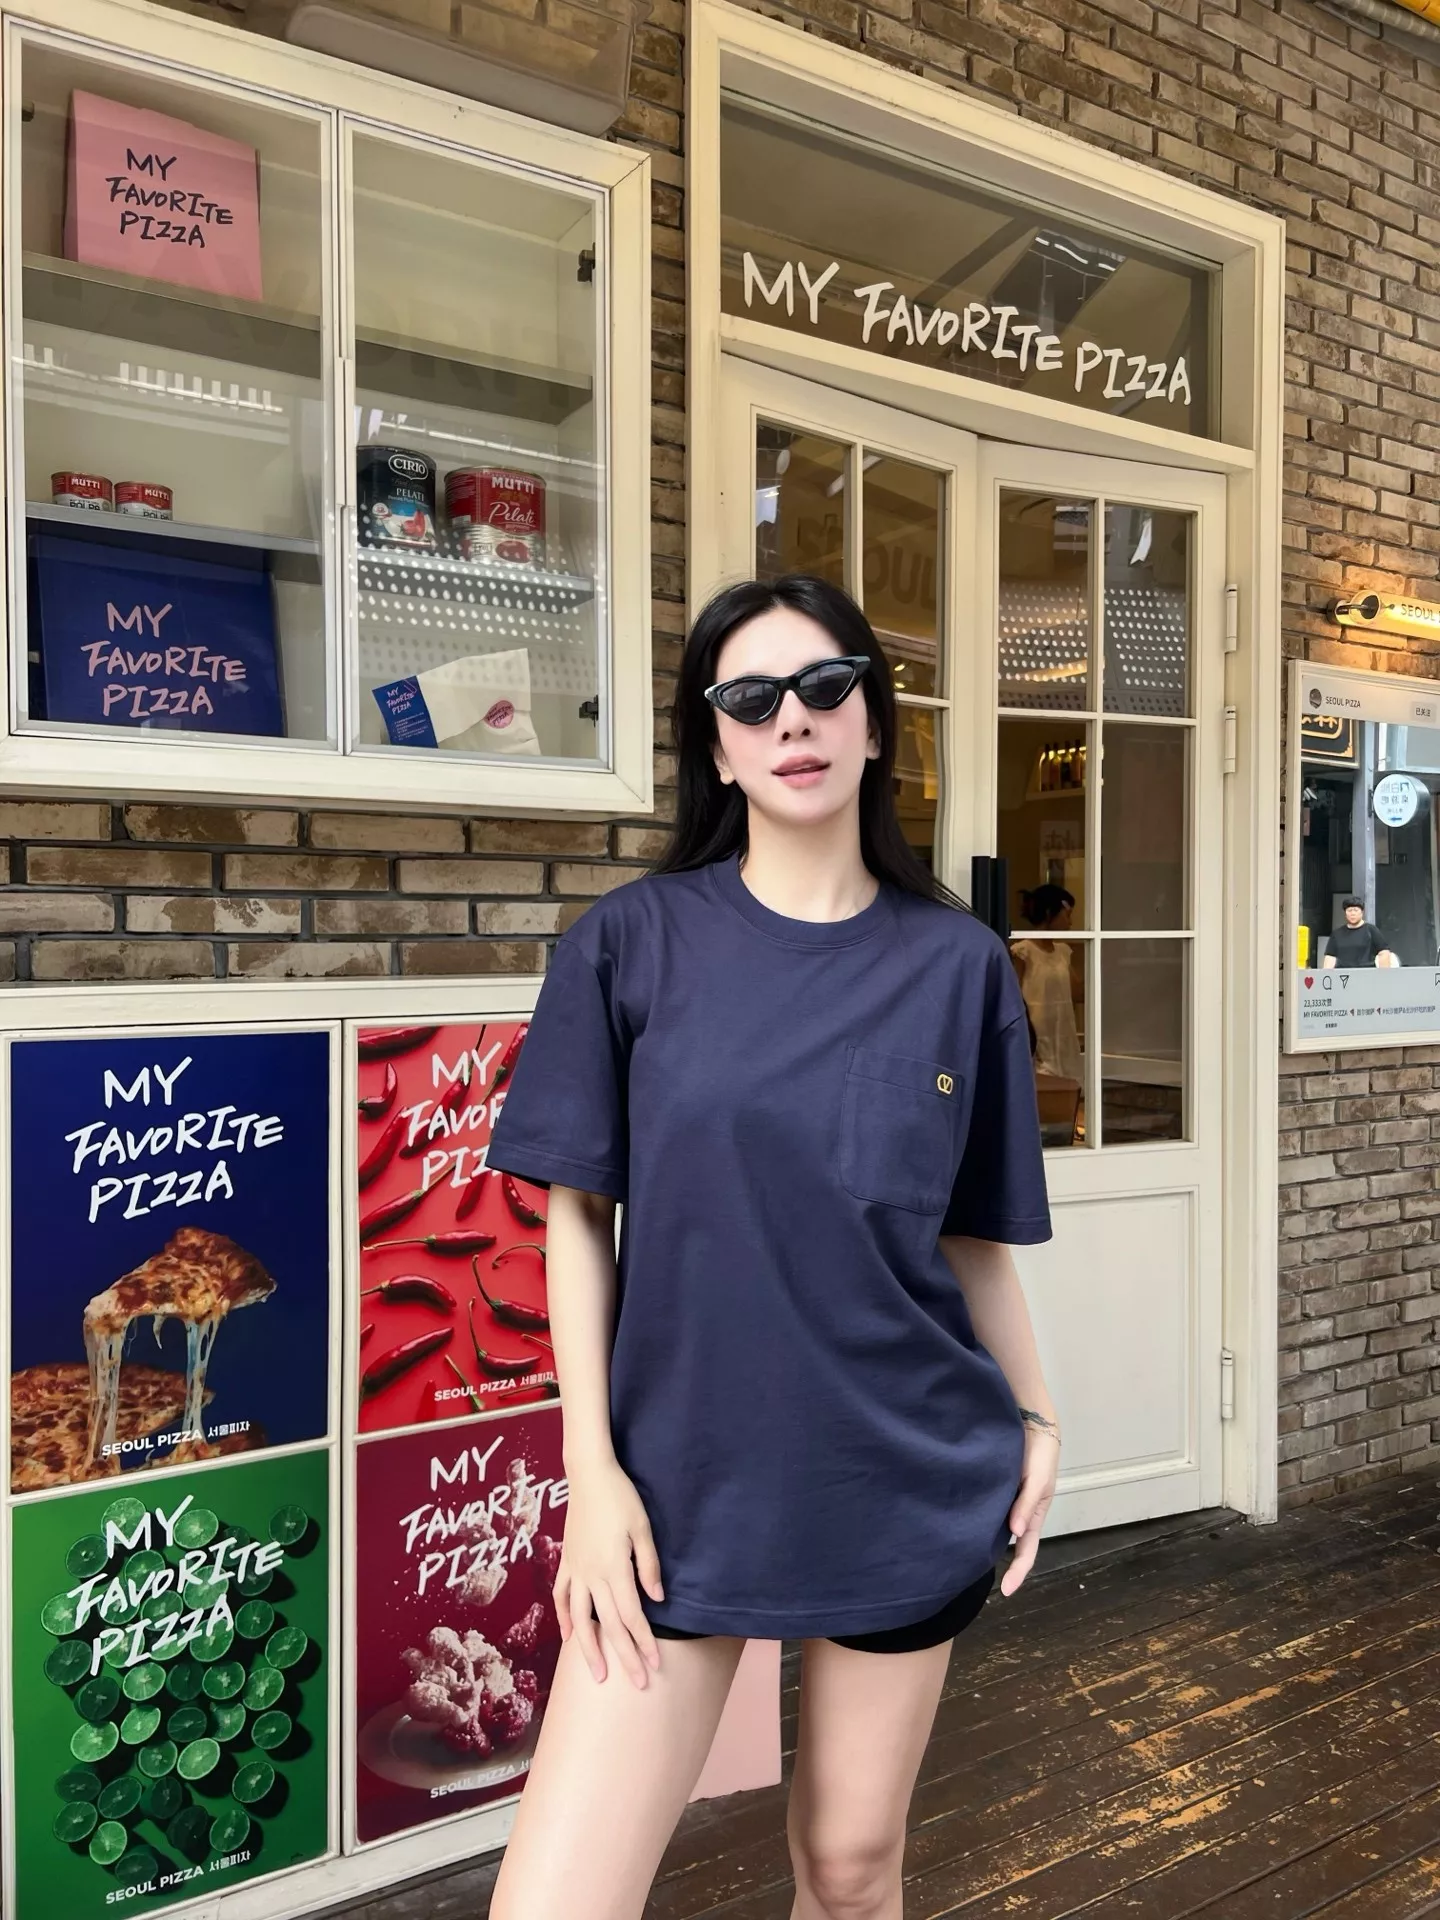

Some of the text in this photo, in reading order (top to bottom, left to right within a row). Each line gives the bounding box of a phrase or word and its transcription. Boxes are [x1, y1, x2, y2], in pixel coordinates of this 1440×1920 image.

[127, 148, 177, 181] MY
[105, 177, 233, 224] FAVORITE
[120, 211, 205, 248] PIZZA
[743, 252, 1191, 405] MY FAVORITE PIZZA
[71, 478, 100, 489] MUTTI
[393, 458, 426, 474] CIRIO
[144, 487, 170, 500] MUTTI
[396, 487, 425, 502] PELATI
[491, 476, 534, 494] MUTTI
[488, 501, 535, 524] Pelati
[106, 602, 173, 638] MY
[1400, 603, 1436, 622] SEOUL
[80, 640, 247, 683] FAVORITE
[102, 684, 214, 718] PIZZA
[1325, 695, 1361, 708] SEOUL PIZZA
[1310, 1009, 1334, 1018] FAVORITE
[1333, 1009, 1348, 1017] PIZZA
[104, 1055, 193, 1110] MY
[431, 1040, 503, 1089] MY
[400, 1091, 508, 1148] FAVOR
[64, 1104, 285, 1175] FAVORITE
[88, 1159, 234, 1224] PIZZA
[432, 1385, 477, 1402] SEOUL
[480, 1378, 517, 1394] PIZZA
[101, 1438, 154, 1457] SEOUL
[157, 1428, 203, 1448] PIZZA
[430, 1435, 504, 1492] MY
[106, 1494, 194, 1560] MY
[399, 1473, 569, 1554] FAVORITE
[417, 1524, 534, 1596] PIZZA
[66, 1536, 285, 1630] FAVORITE
[89, 1593, 235, 1677] PIZZA
[430, 1776, 475, 1799] SEOUL
[477, 1764, 516, 1785] PIZZA
[105, 1879, 158, 1906] SEOUL
[159, 1864, 205, 1890] PIZZA
